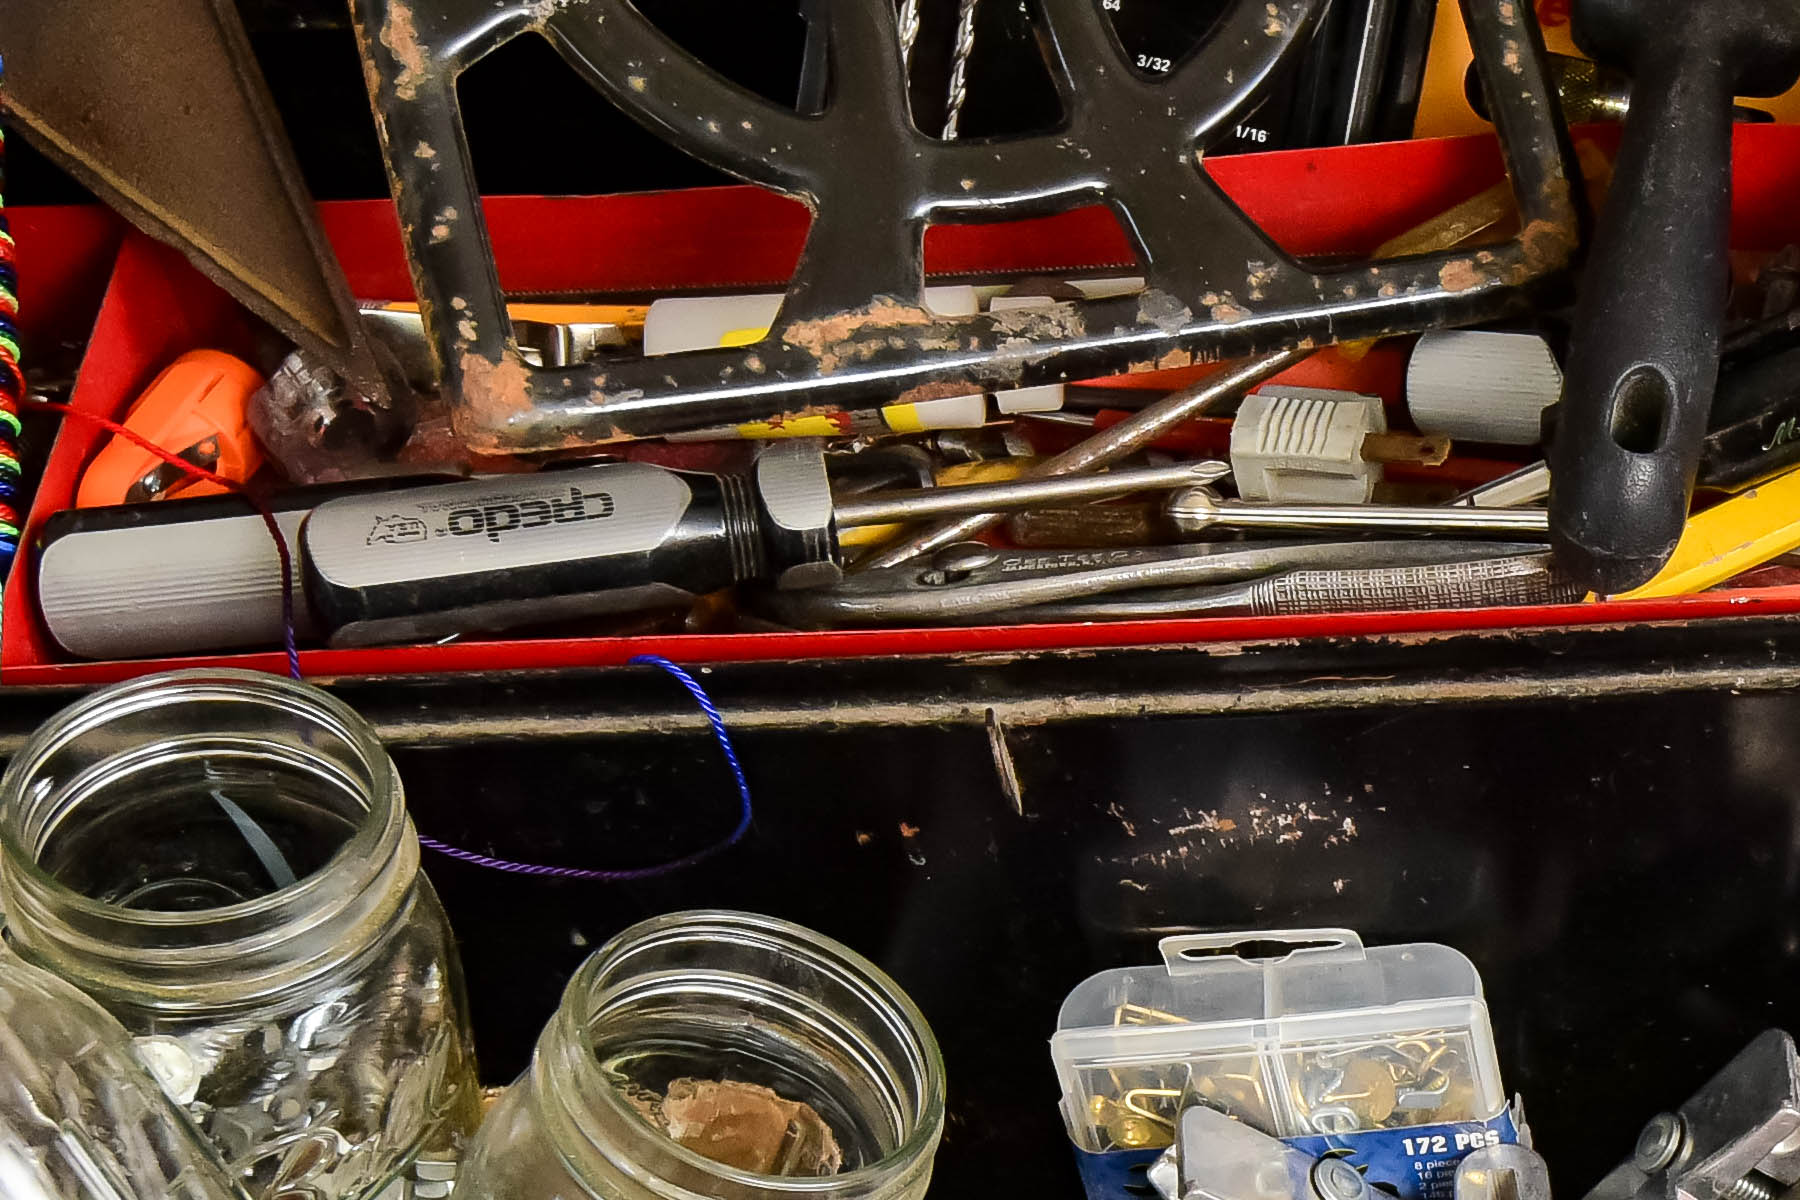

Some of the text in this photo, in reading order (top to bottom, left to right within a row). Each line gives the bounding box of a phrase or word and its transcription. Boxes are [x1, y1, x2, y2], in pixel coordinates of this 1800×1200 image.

[1136, 54, 1171, 72] 3/32
[1235, 125, 1268, 142] 1/16
[1402, 1130, 1500, 1155] 172 PCS
